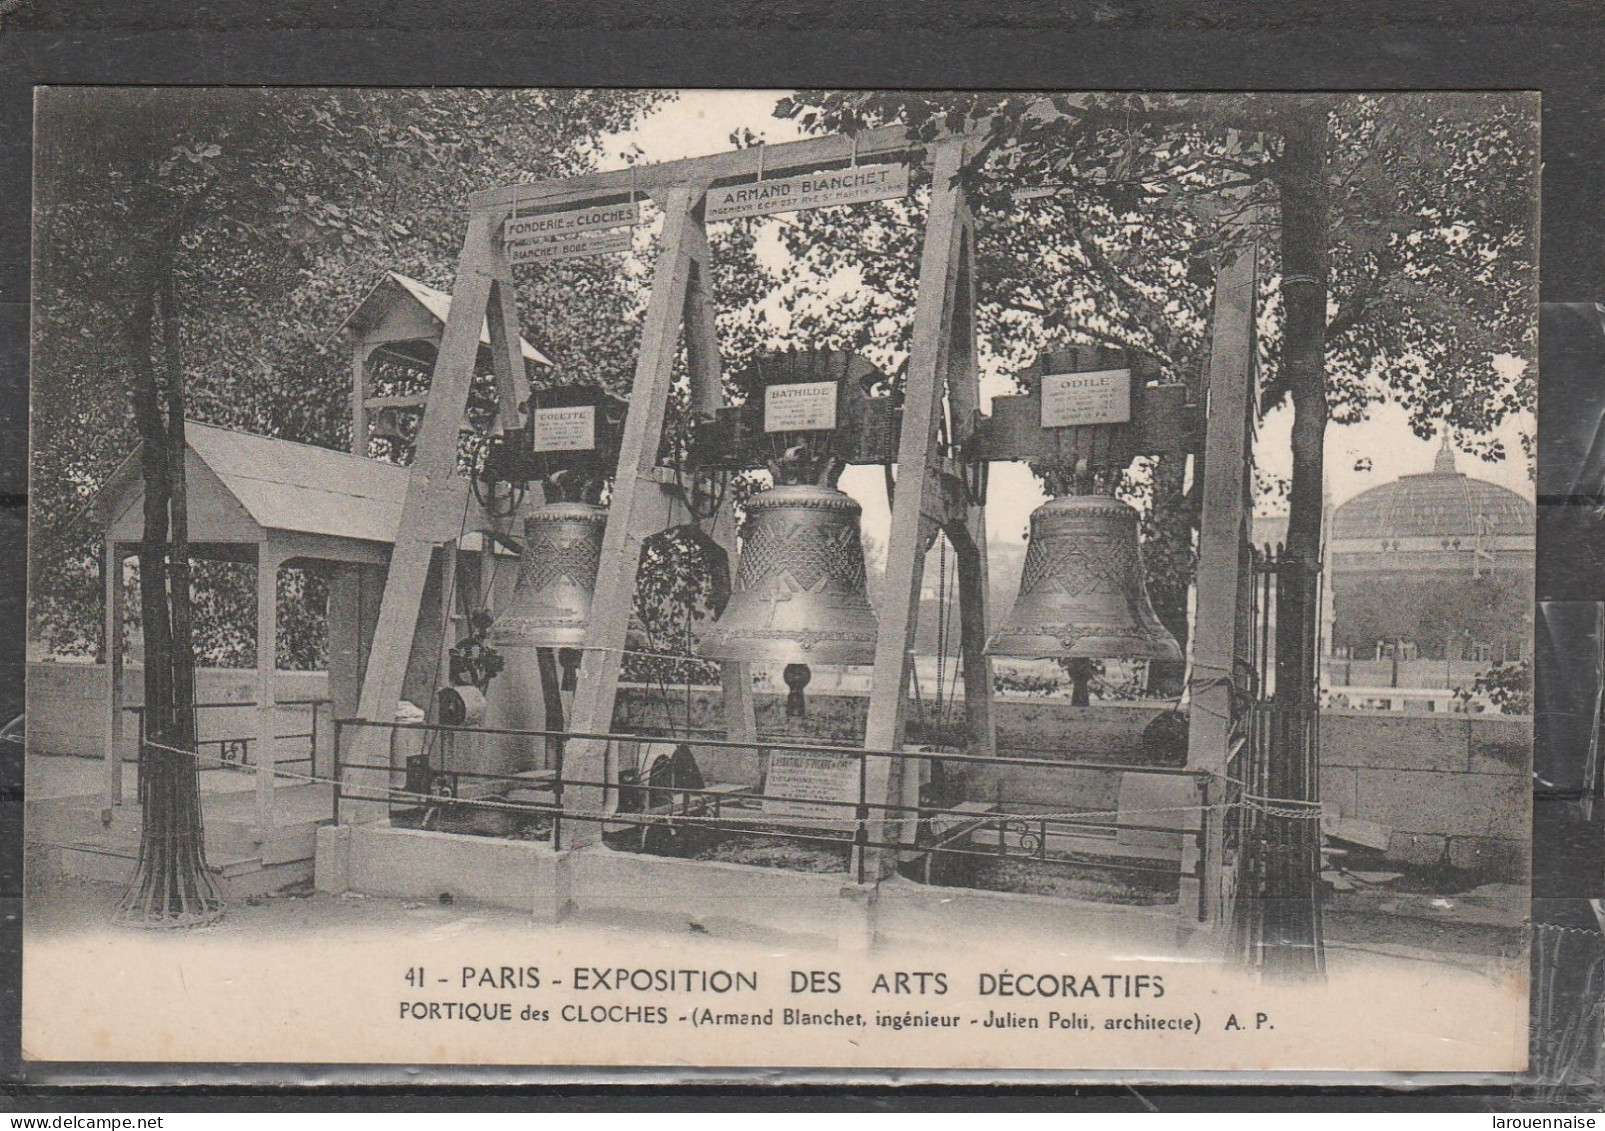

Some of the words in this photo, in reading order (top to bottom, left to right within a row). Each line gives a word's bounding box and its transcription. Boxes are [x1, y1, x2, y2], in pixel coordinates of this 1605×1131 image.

[723, 184, 790, 204] ARMAND
[802, 170, 890, 193] BLANCHET
[508, 217, 564, 235] FONDERIE
[577, 208, 634, 226] CLOCHES
[512, 245, 558, 260] BLANCHET
[1060, 377, 1110, 389] ODILE
[772, 387, 829, 399] BATHILDE
[540, 411, 586, 421] COLETTE
